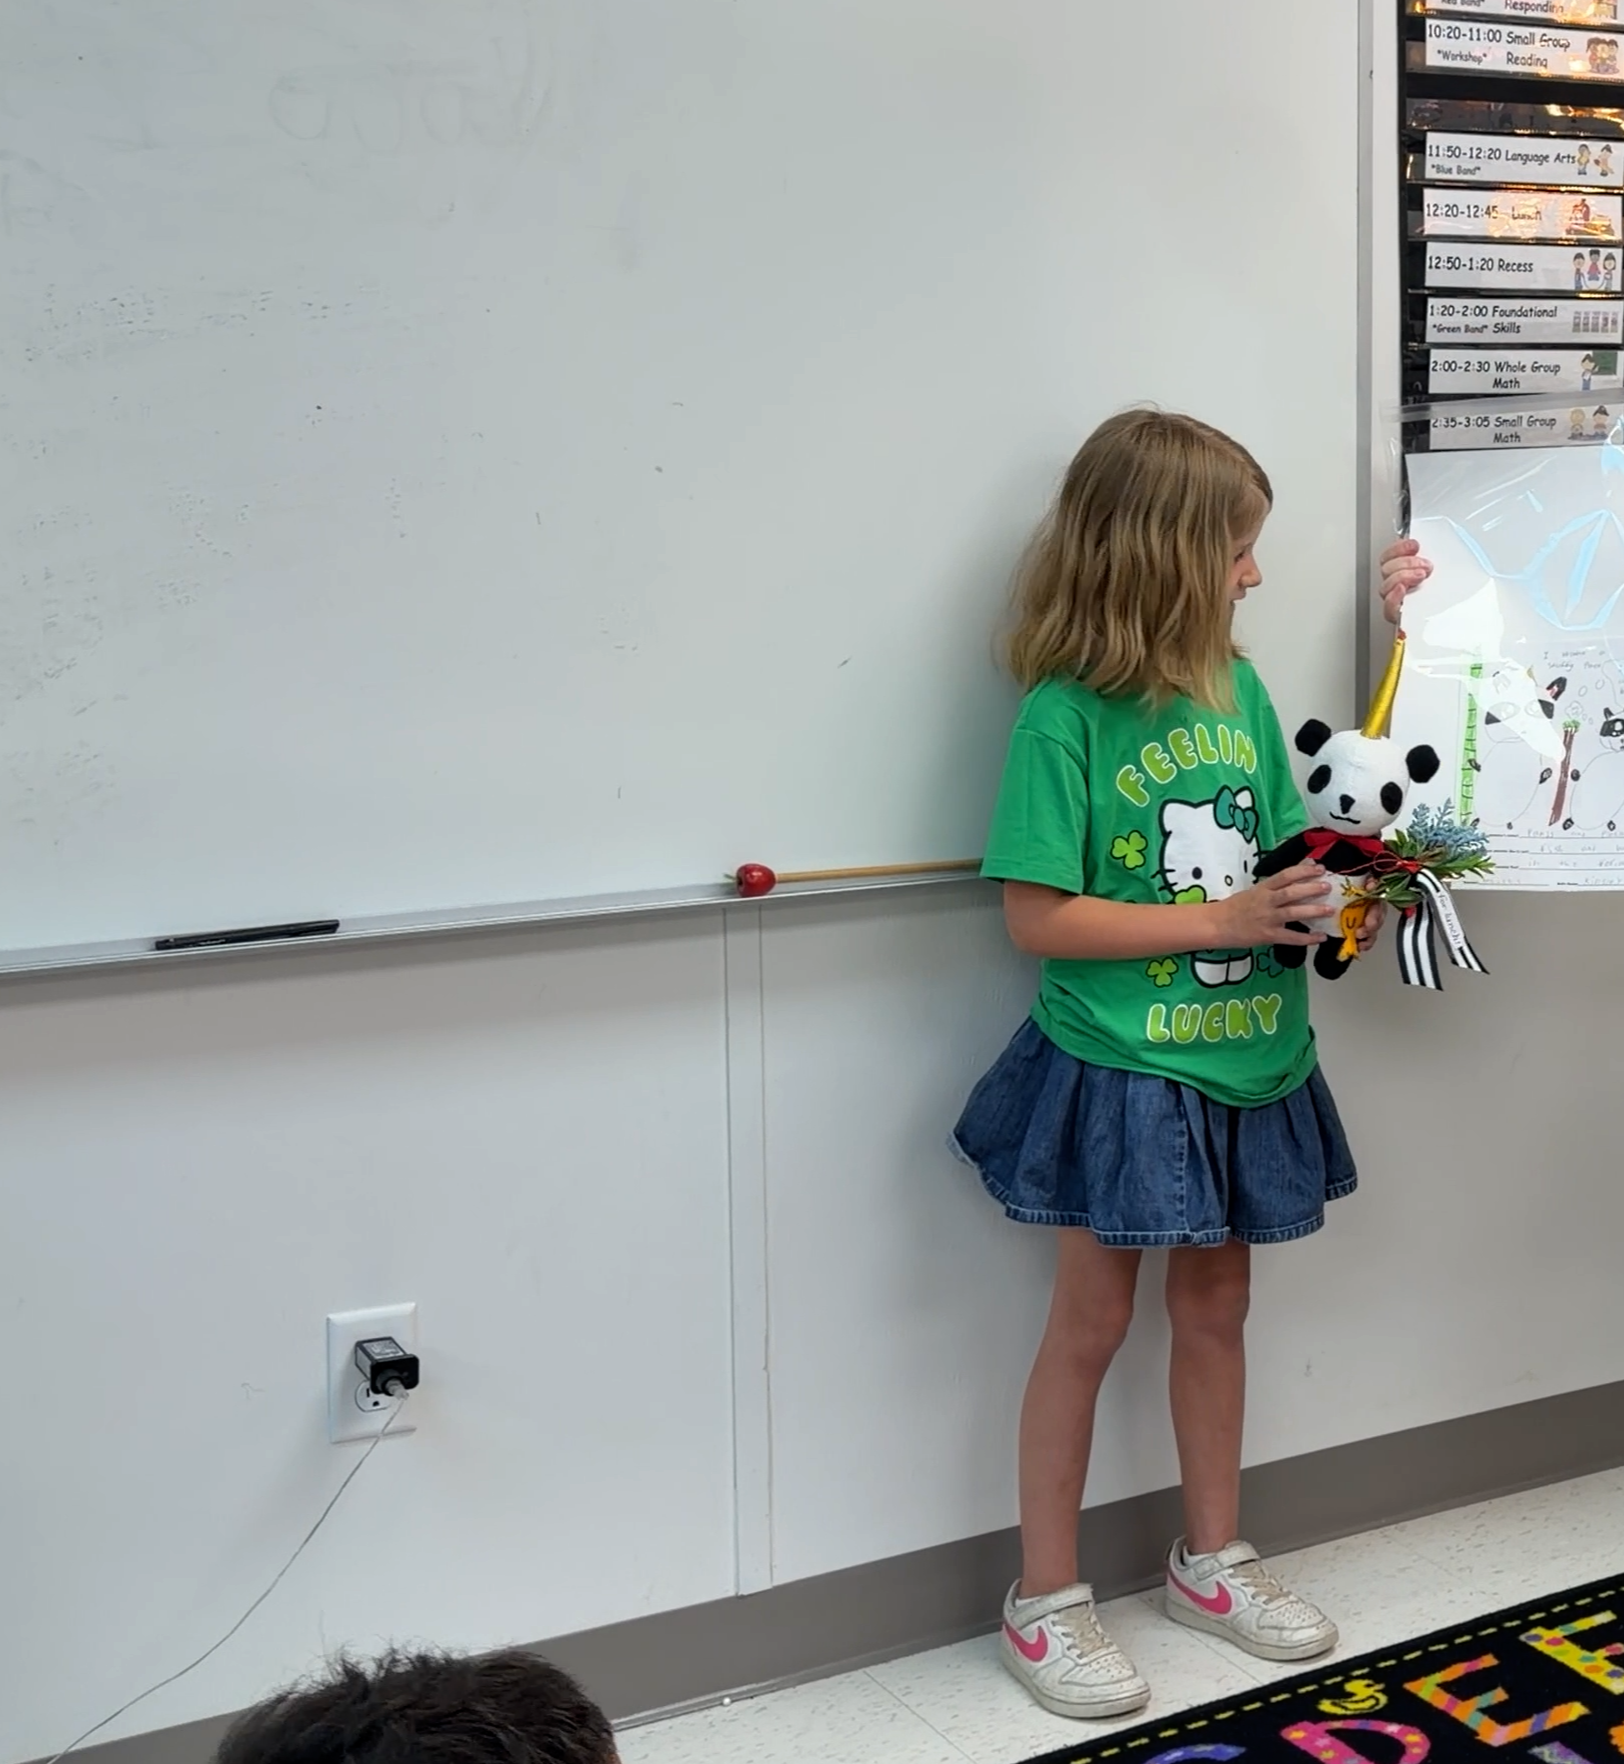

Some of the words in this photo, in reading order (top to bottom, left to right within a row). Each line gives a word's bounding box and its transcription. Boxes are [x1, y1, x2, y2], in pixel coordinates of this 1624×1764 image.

[1427, 24, 1502, 43] 10:20-11:00
[1505, 31, 1535, 46] Small
[1506, 51, 1548, 68] Reading
[1427, 144, 1502, 161] 11:50-12:20
[1504, 150, 1550, 166] Language
[1553, 152, 1576, 164] Arts
[1426, 203, 1499, 220] 12:20-12:45
[1427, 255, 1494, 272] 12:50-1:20
[1497, 257, 1534, 273] Recess
[1429, 305, 1489, 318] 1:20-2:00
[1491, 305, 1558, 319] Foundational
[1492, 322, 1522, 335] Skills
[1431, 360, 1491, 373] 2:00-2:30
[1493, 361, 1527, 374] Whole
[1530, 361, 1562, 376] Group
[1492, 377, 1521, 390] Math
[1431, 415, 1491, 429] 2:35-3:05
[1493, 415, 1523, 428] Small
[1526, 415, 1557, 430] Group
[1492, 431, 1522, 444] Math
[1116, 723, 1258, 808] FEELIN
[1146, 993, 1283, 1044] LUCKY
